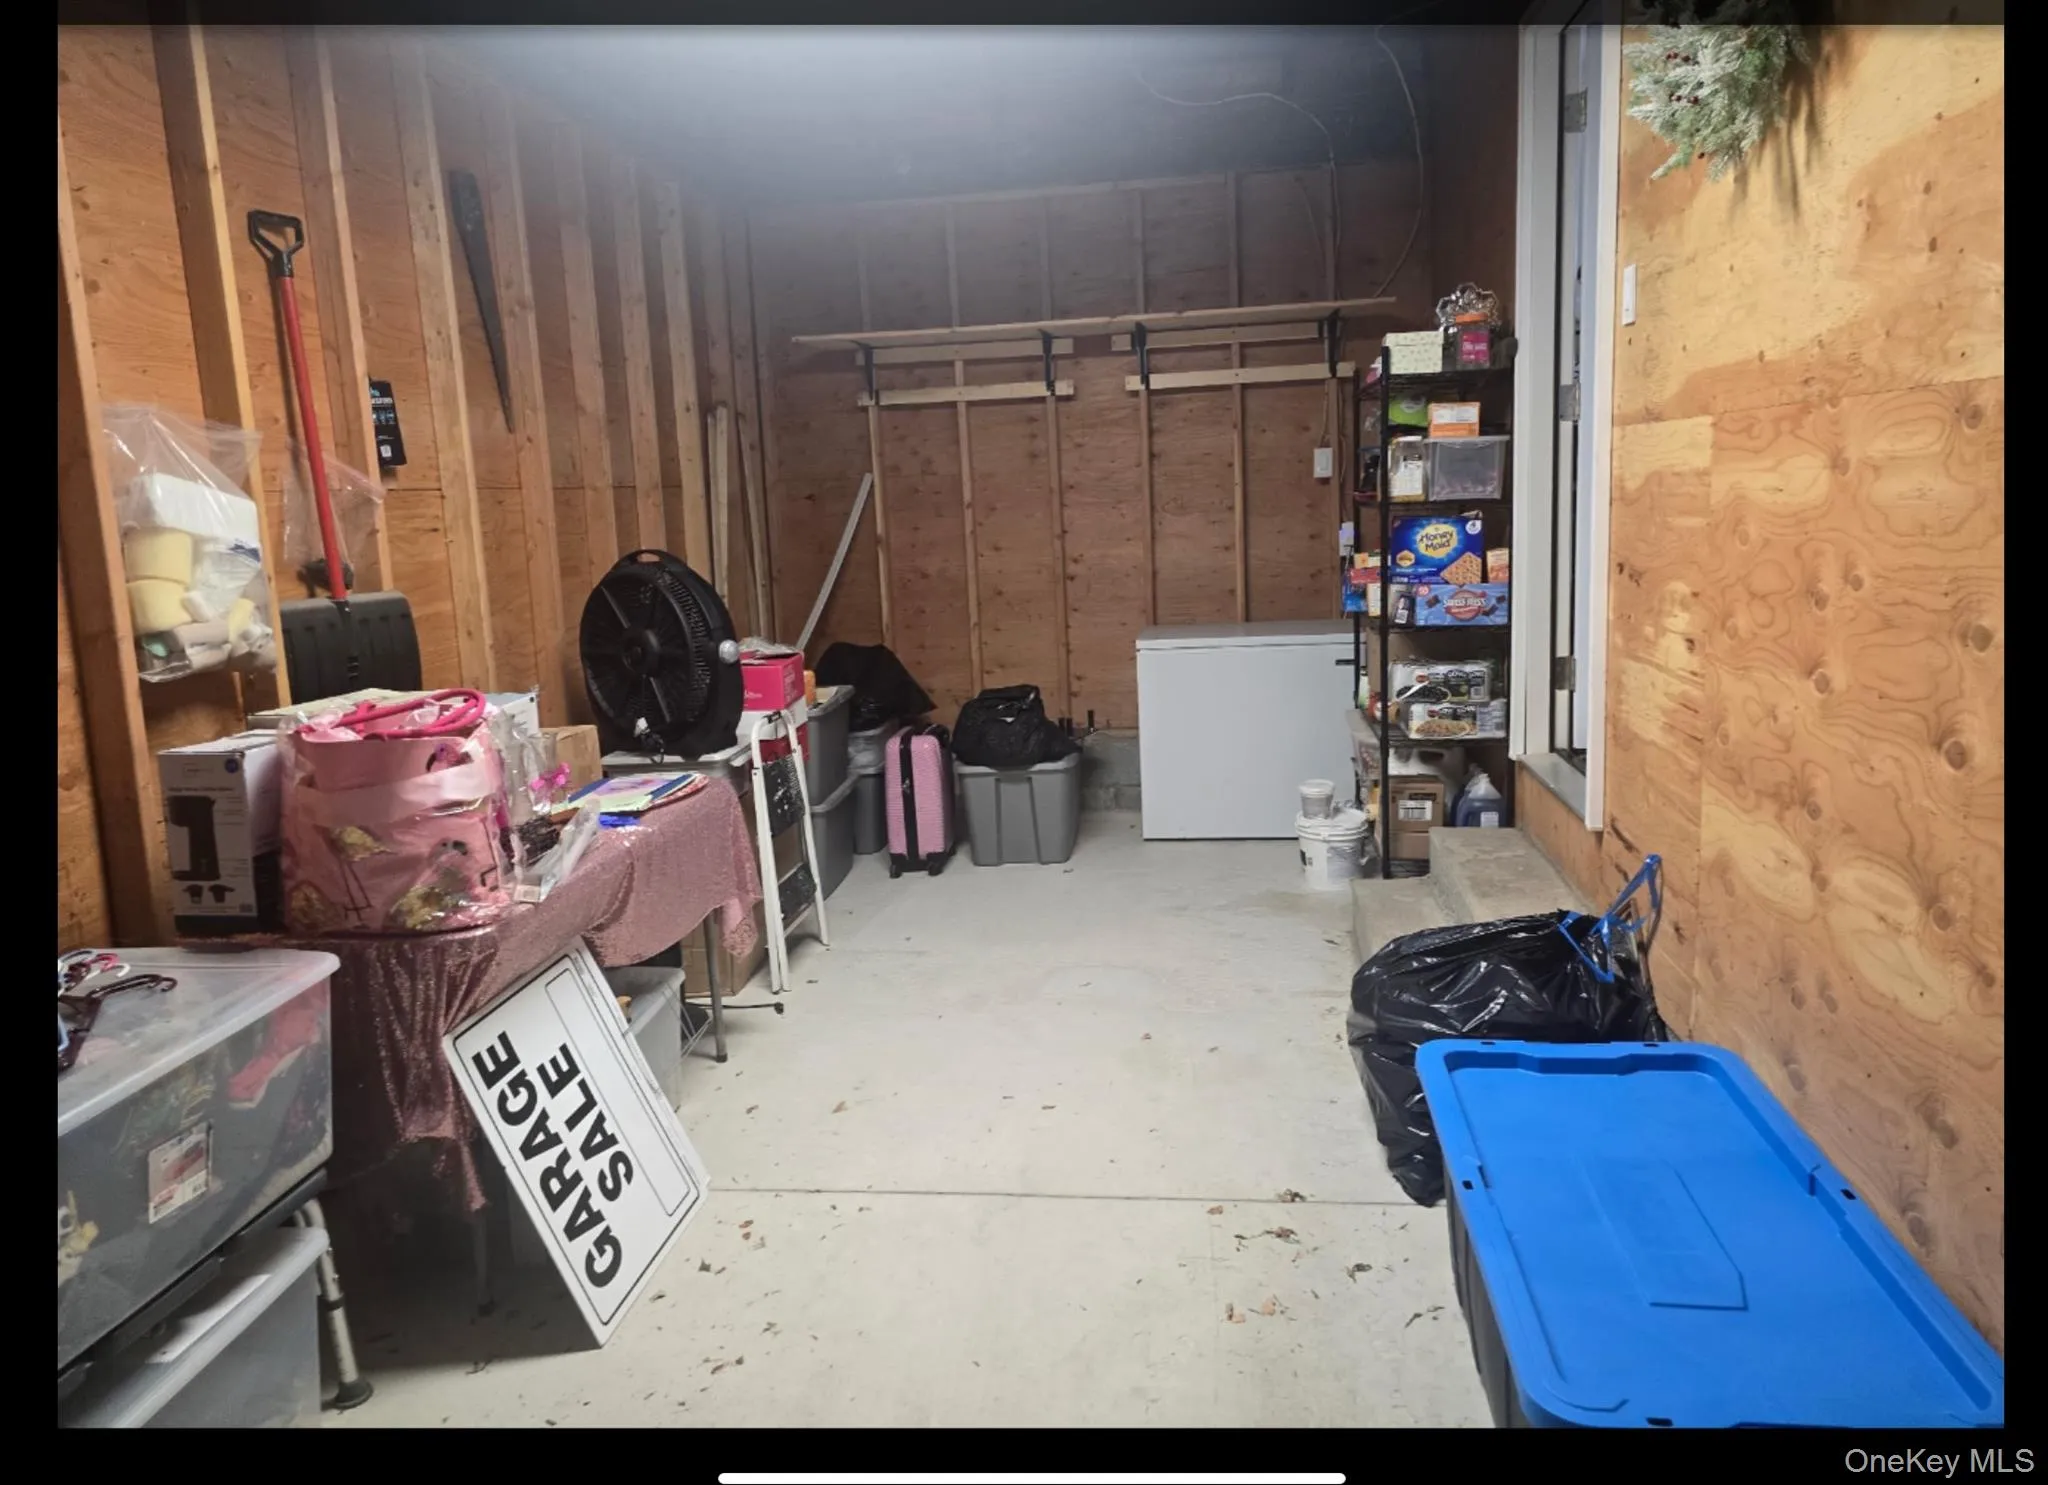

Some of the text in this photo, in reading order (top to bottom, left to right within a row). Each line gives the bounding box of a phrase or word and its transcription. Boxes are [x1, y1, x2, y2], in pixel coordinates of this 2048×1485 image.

[1418, 530, 1454, 544] Honey
[1425, 539, 1450, 552] Maid
[471, 1030, 622, 1288] GARAGE
[536, 1043, 634, 1202] SALE
